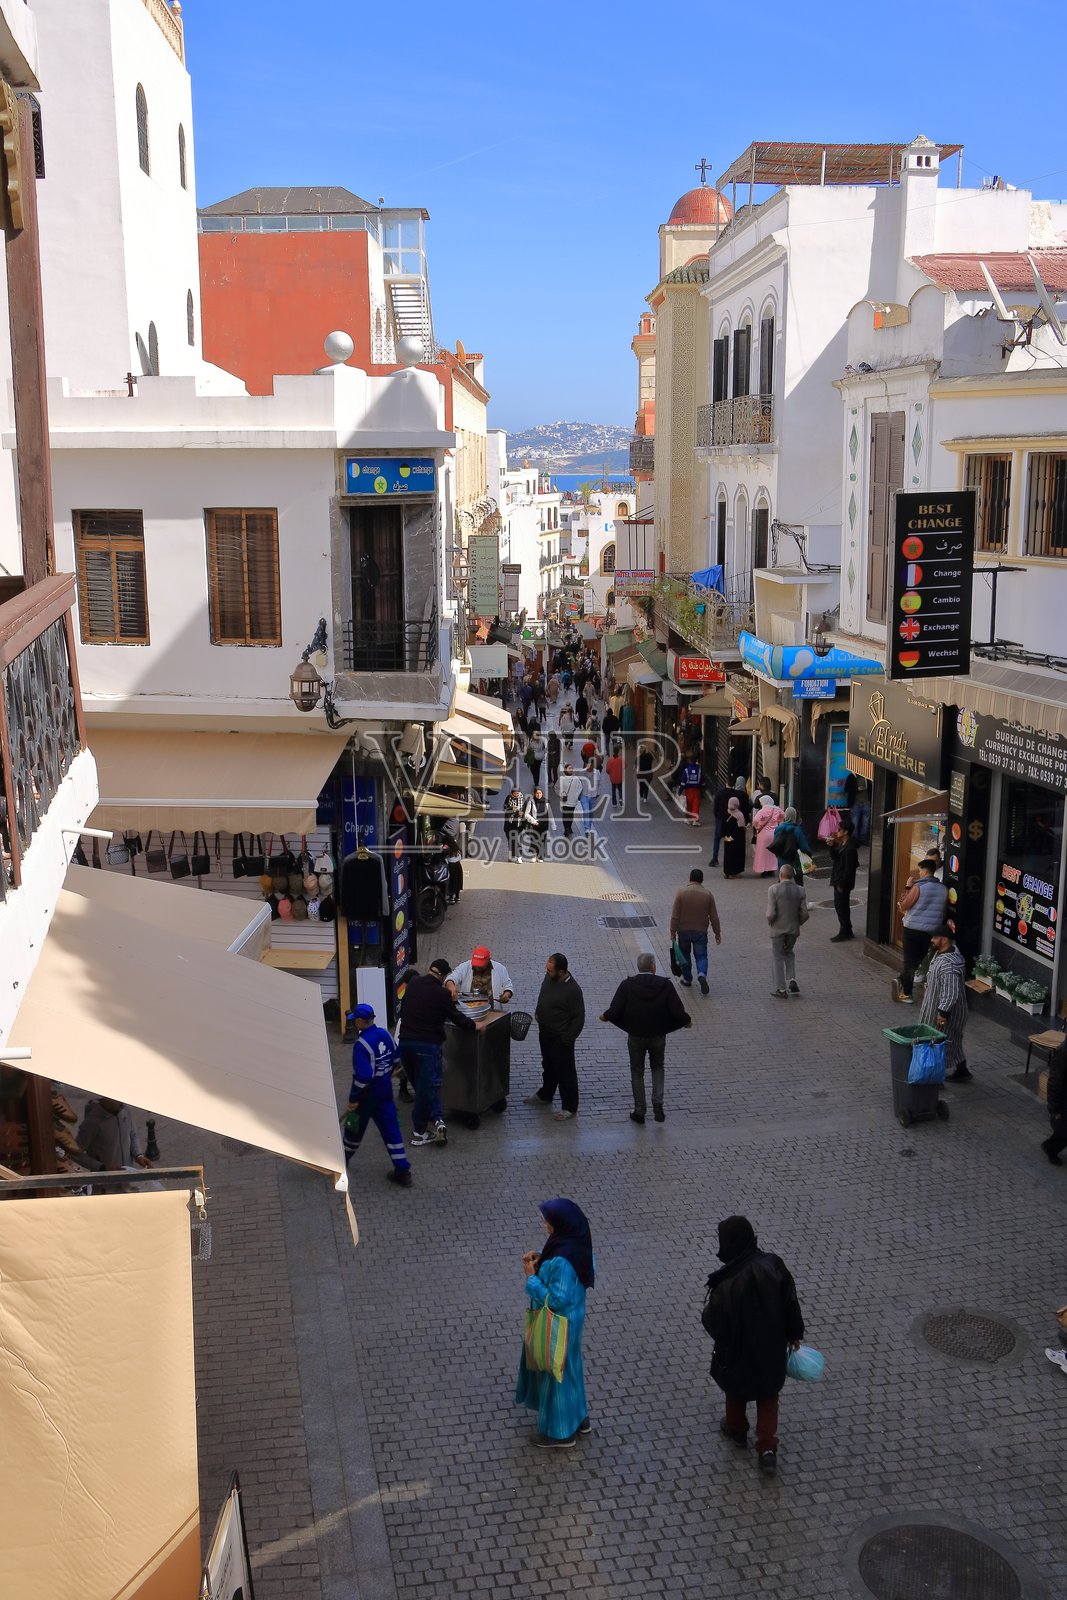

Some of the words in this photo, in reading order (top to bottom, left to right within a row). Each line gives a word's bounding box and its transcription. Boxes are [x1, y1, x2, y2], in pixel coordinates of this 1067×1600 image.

[918, 504, 953, 515] BEST
[907, 518, 963, 529] CHANGE
[936, 539, 963, 555] صرف
[933, 570, 962, 578] Change
[923, 624, 960, 632] Exchange
[928, 649, 959, 658] Wechsel
[815, 667, 846, 675] BUREAU
[877, 726, 891, 746] El
[889, 731, 909, 753] rida
[995, 729, 1024, 747] BUREAU
[1025, 739, 1035, 751] DE
[1037, 743, 1067, 761] CHANGE
[858, 736, 926, 776] BIJOUTERIE
[985, 739, 1017, 757] CURRENCY
[1018, 749, 1053, 769] EXCHANGE
[988, 752, 1001, 766] 0539
[1002, 757, 1008, 768] 37
[1009, 760, 1016, 771] 31
[1017, 762, 1024, 774] 00
[1028, 765, 1039, 779] FAX:
[1040, 769, 1054, 784] 0539
[1055, 775, 1063, 788] 37
[345, 821, 374, 836] Change
[1002, 863, 1021, 885] BEST
[1022, 873, 1054, 900] CHANGE
